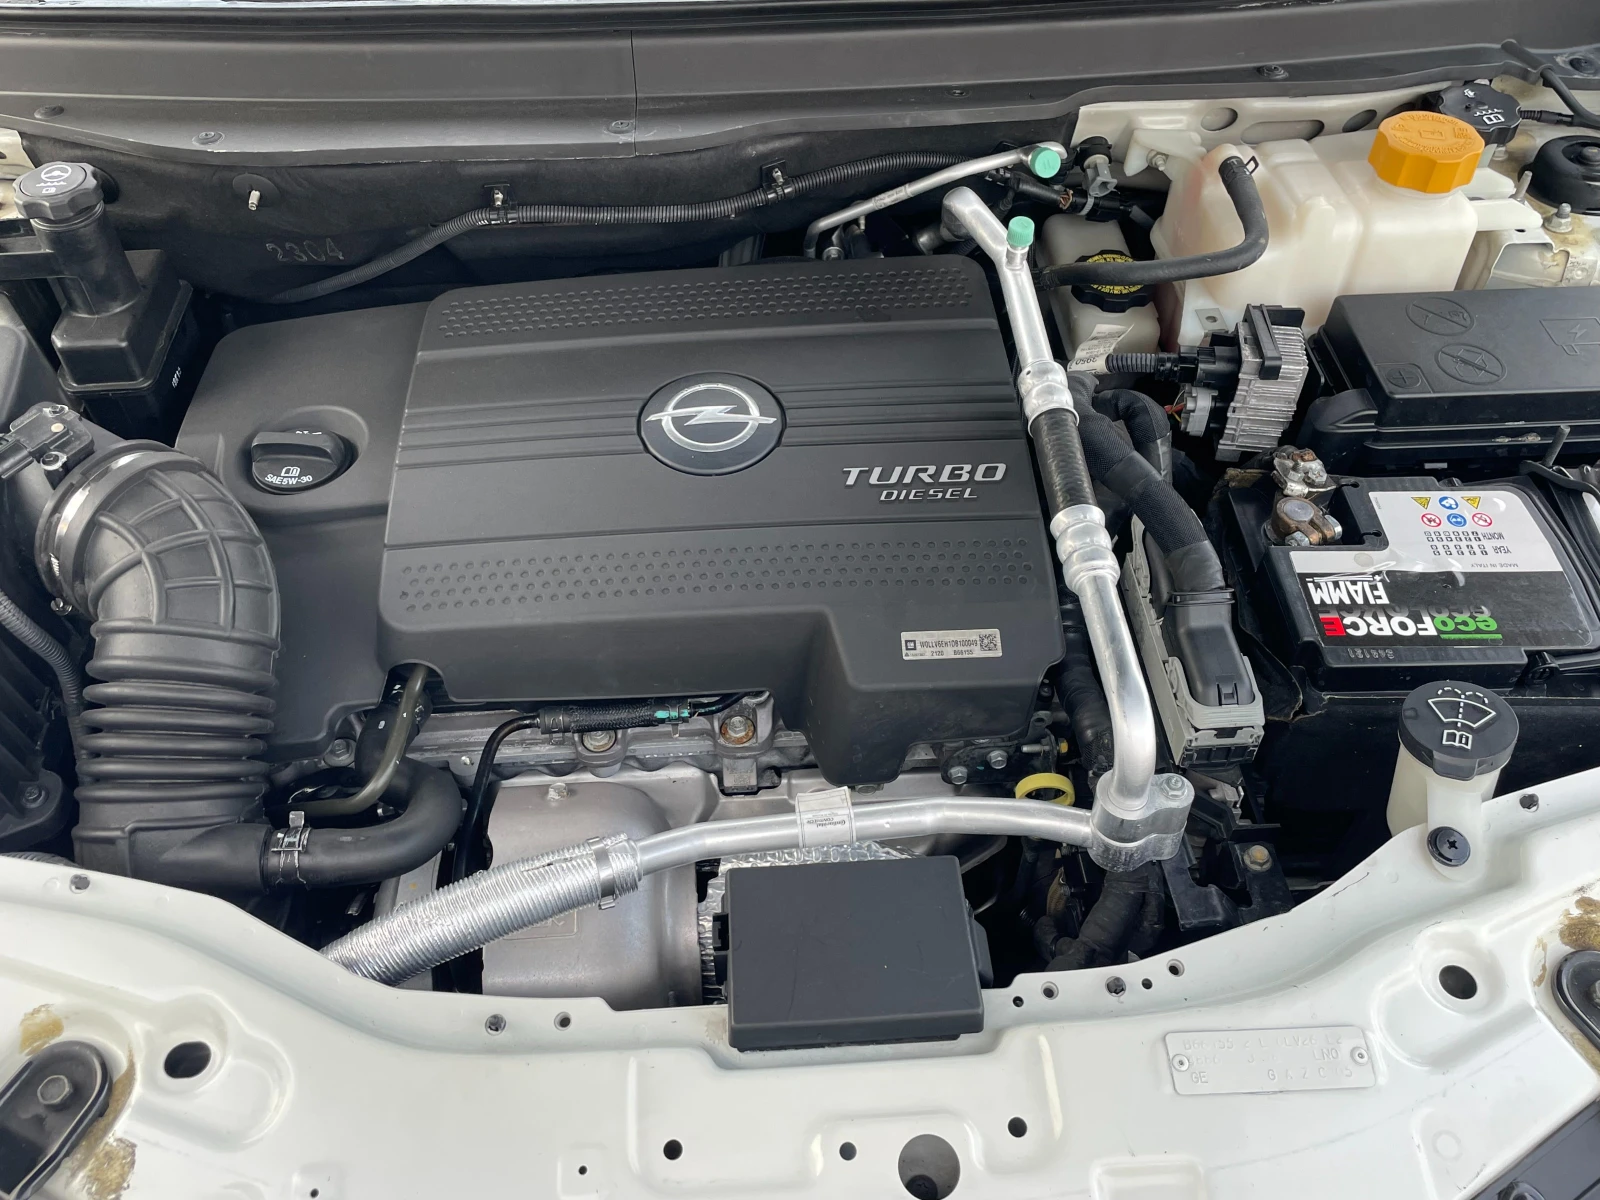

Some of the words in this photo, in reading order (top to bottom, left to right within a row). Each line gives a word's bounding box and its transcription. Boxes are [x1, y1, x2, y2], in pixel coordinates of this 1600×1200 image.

[265, 237, 345, 262] 2304
[842, 461, 1008, 487] TURBO
[878, 487, 978, 502] DIESEL
[1481, 532, 1505, 540] MONTH
[1492, 545, 1511, 554] YEAR
[1306, 580, 1390, 605] FIAMM
[1319, 615, 1498, 636] ecoFORCE
[1190, 1071, 1209, 1084] GE
